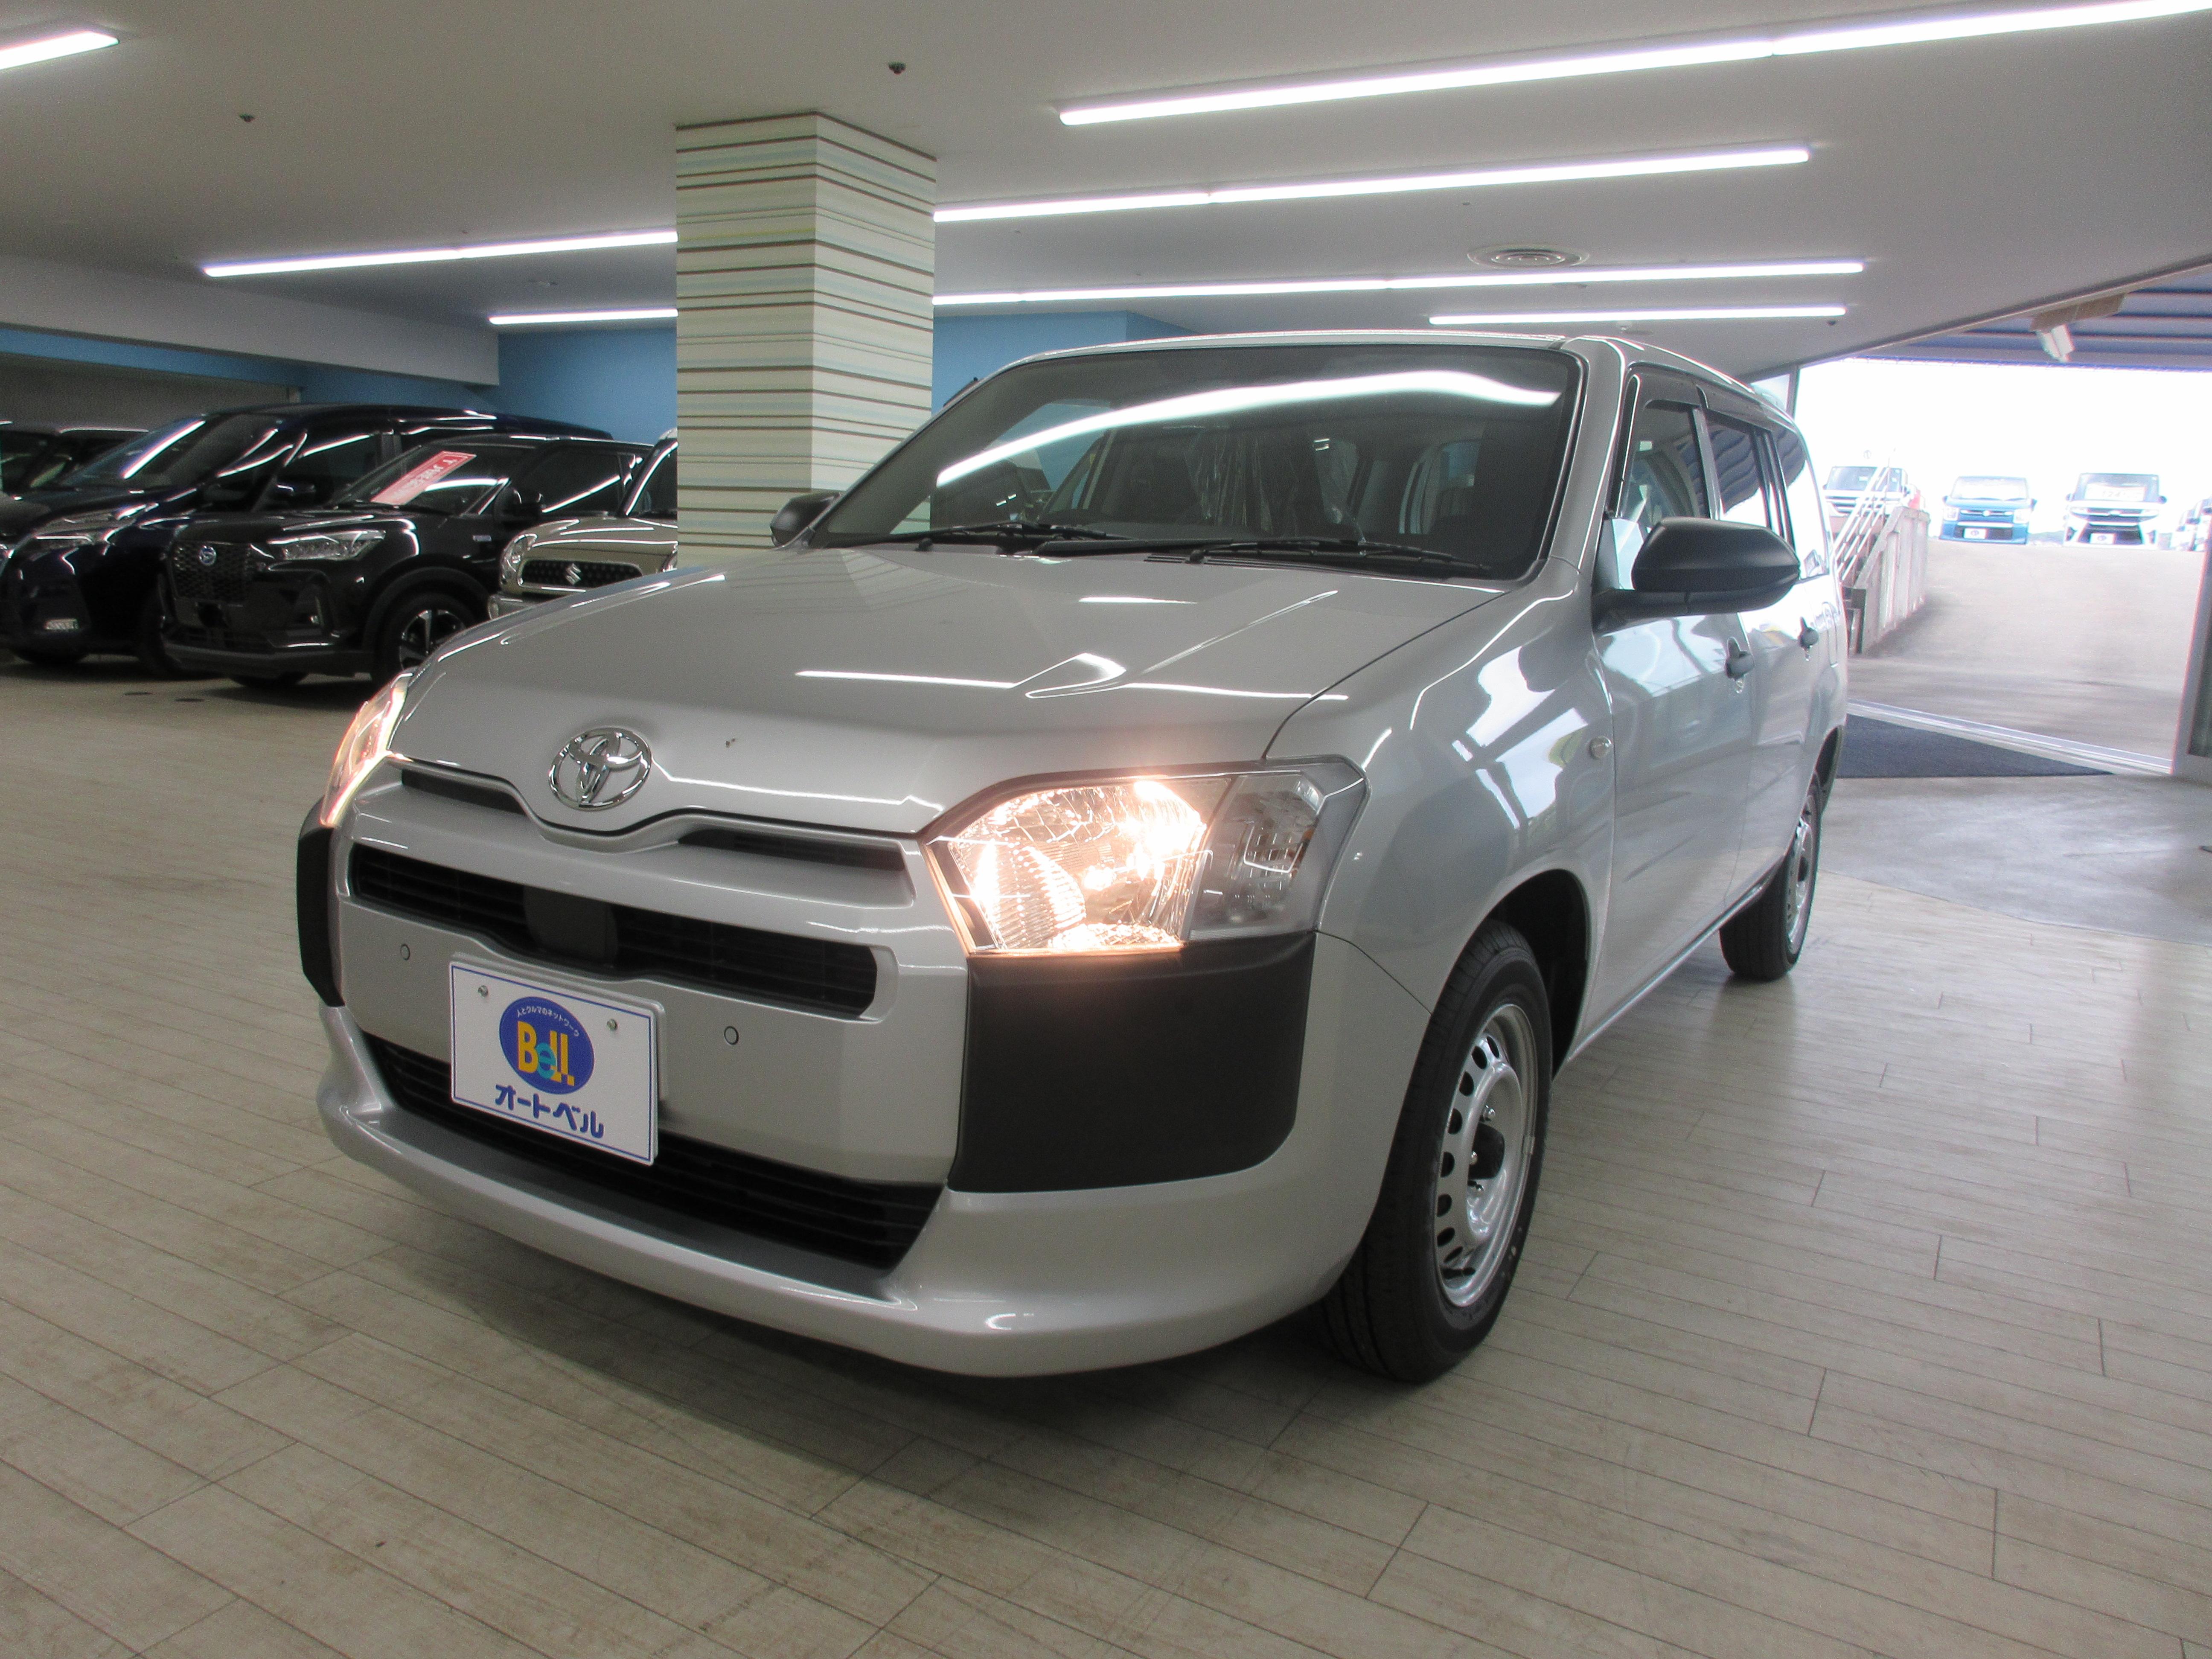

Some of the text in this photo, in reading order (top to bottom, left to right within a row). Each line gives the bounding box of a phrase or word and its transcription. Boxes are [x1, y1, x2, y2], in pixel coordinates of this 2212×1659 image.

[495, 1084, 604, 1138] オートベル
